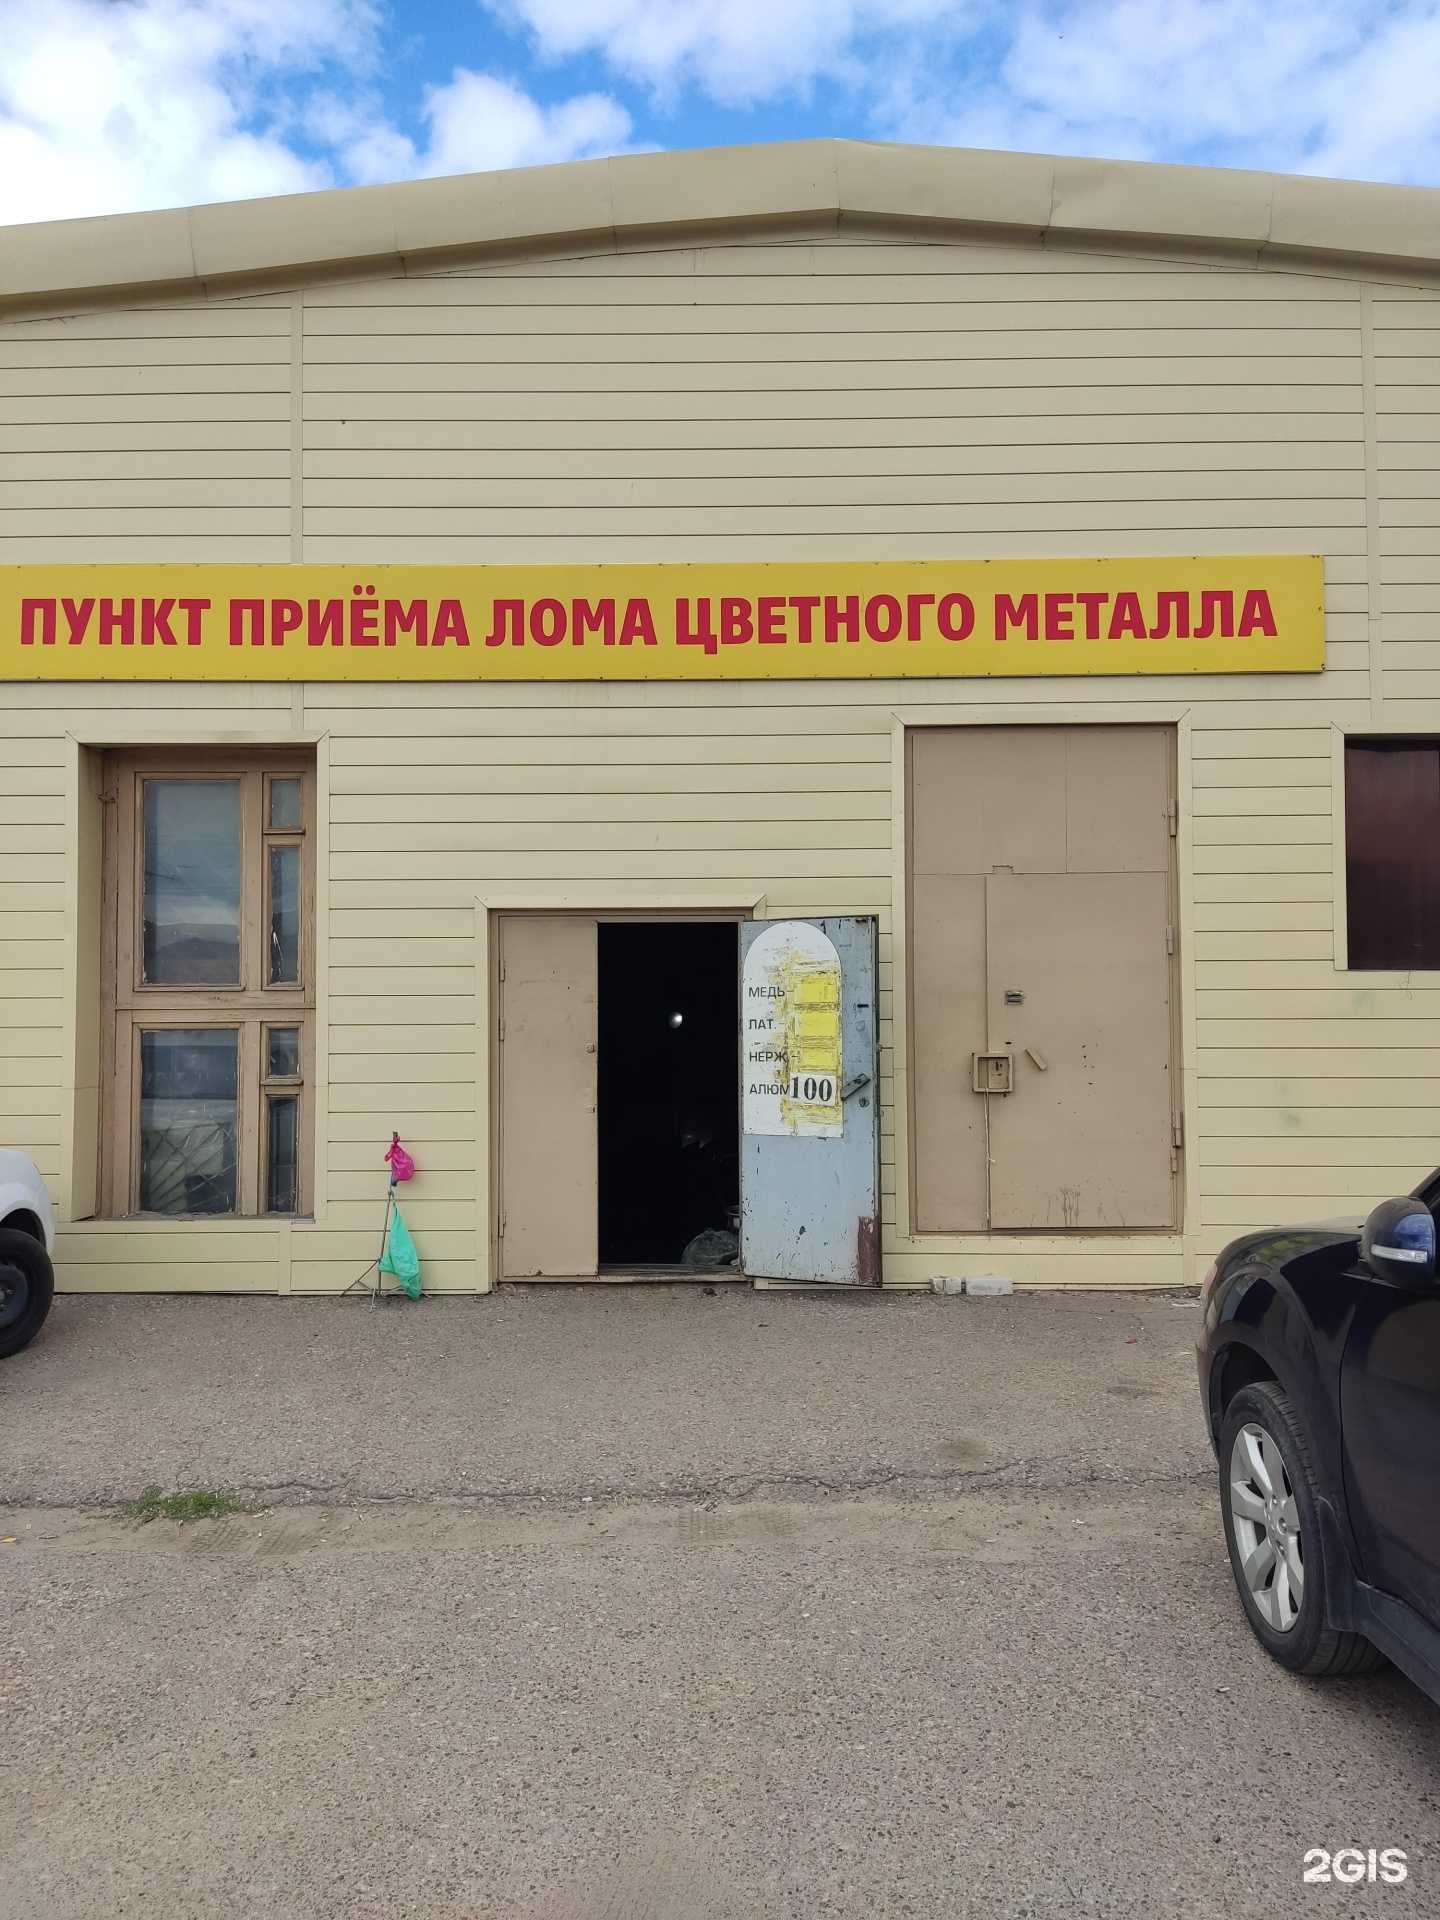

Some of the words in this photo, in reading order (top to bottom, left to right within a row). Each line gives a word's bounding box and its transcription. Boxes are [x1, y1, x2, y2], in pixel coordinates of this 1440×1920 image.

[20, 598, 211, 646] ПУНКТ
[229, 584, 470, 647] ПРИЁМА
[485, 598, 658, 647] ЛОМА
[675, 592, 975, 655] ЦВЕТНОГО
[994, 589, 1278, 641] МЕТАЛЛА
[748, 986, 786, 999] МЕДЬ
[791, 1076, 833, 1102] 100
